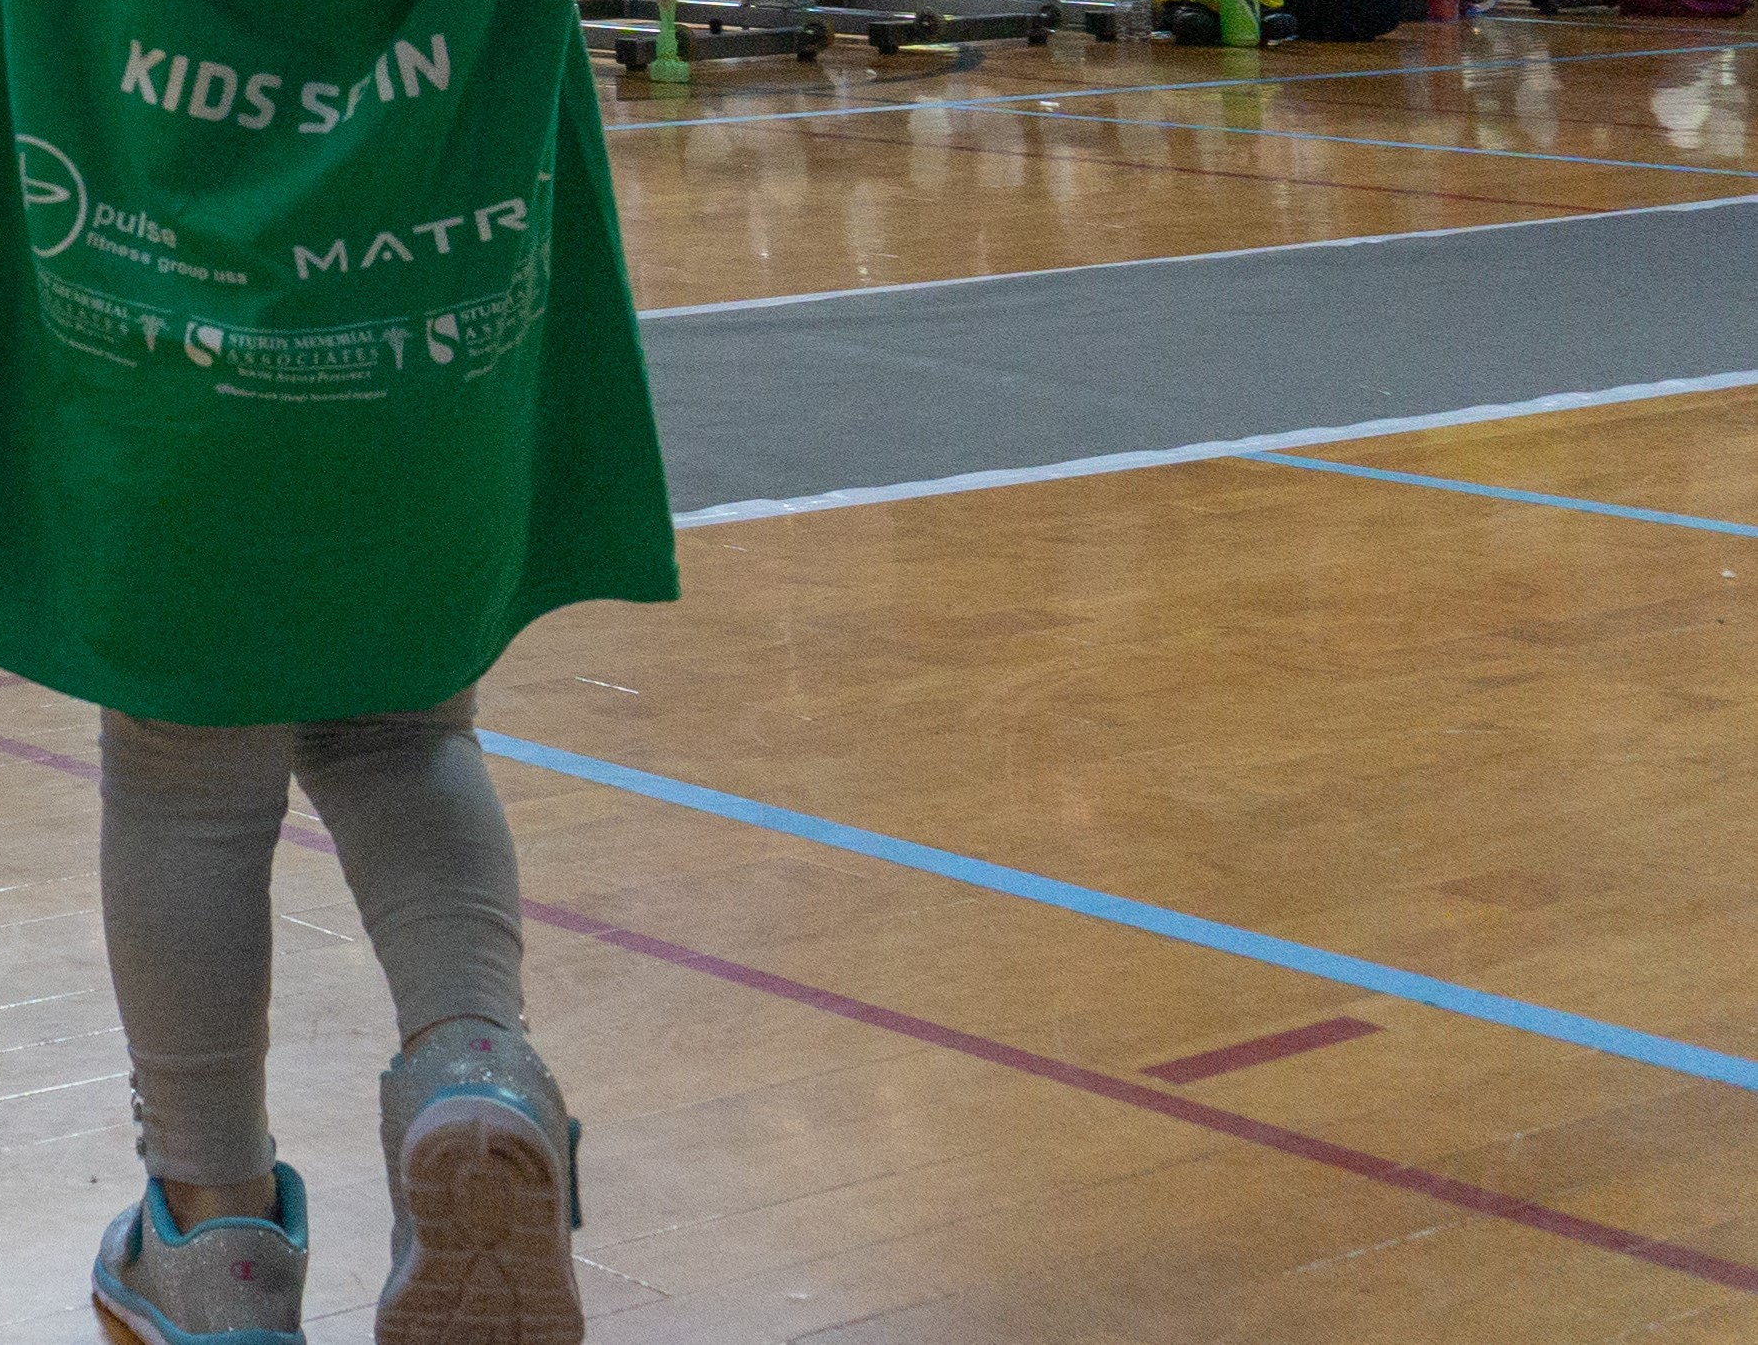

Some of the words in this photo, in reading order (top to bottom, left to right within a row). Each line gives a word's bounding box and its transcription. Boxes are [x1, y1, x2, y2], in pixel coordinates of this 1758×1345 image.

[120, 38, 283, 130] KIDS
[92, 202, 177, 250] pulse
[293, 197, 529, 281] MATR
